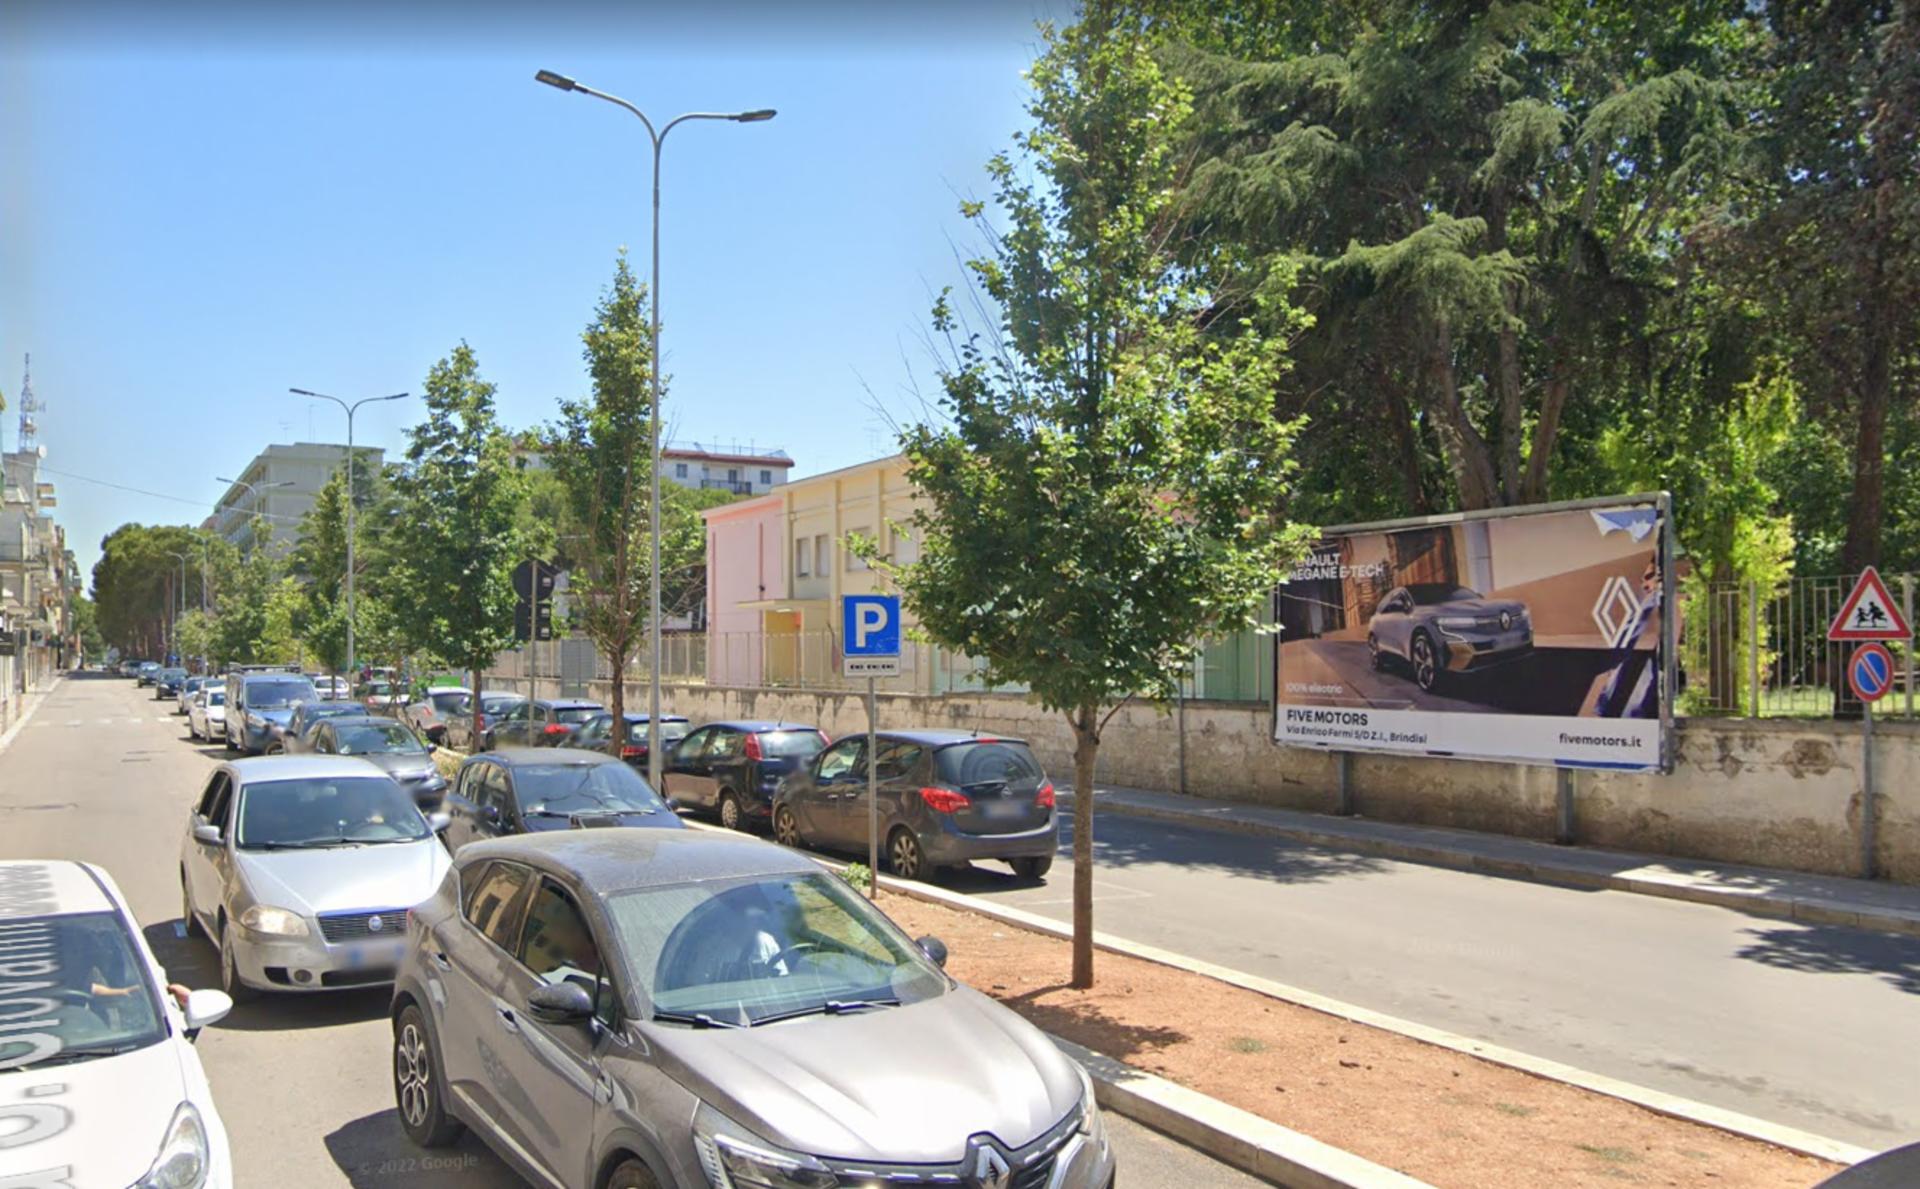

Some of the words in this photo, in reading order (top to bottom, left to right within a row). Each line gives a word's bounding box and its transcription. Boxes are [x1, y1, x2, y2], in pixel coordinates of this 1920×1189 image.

[855, 602, 888, 648] P
[1309, 682, 1343, 695] electric
[1287, 709, 1313, 722] FIVE
[1315, 711, 1368, 726] MOTORS
[1286, 725, 1300, 735] Via
[1301, 726, 1327, 737] Enrico
[1390, 732, 1428, 744] Brindisi
[1559, 732, 1642, 747] fivemotors.it
